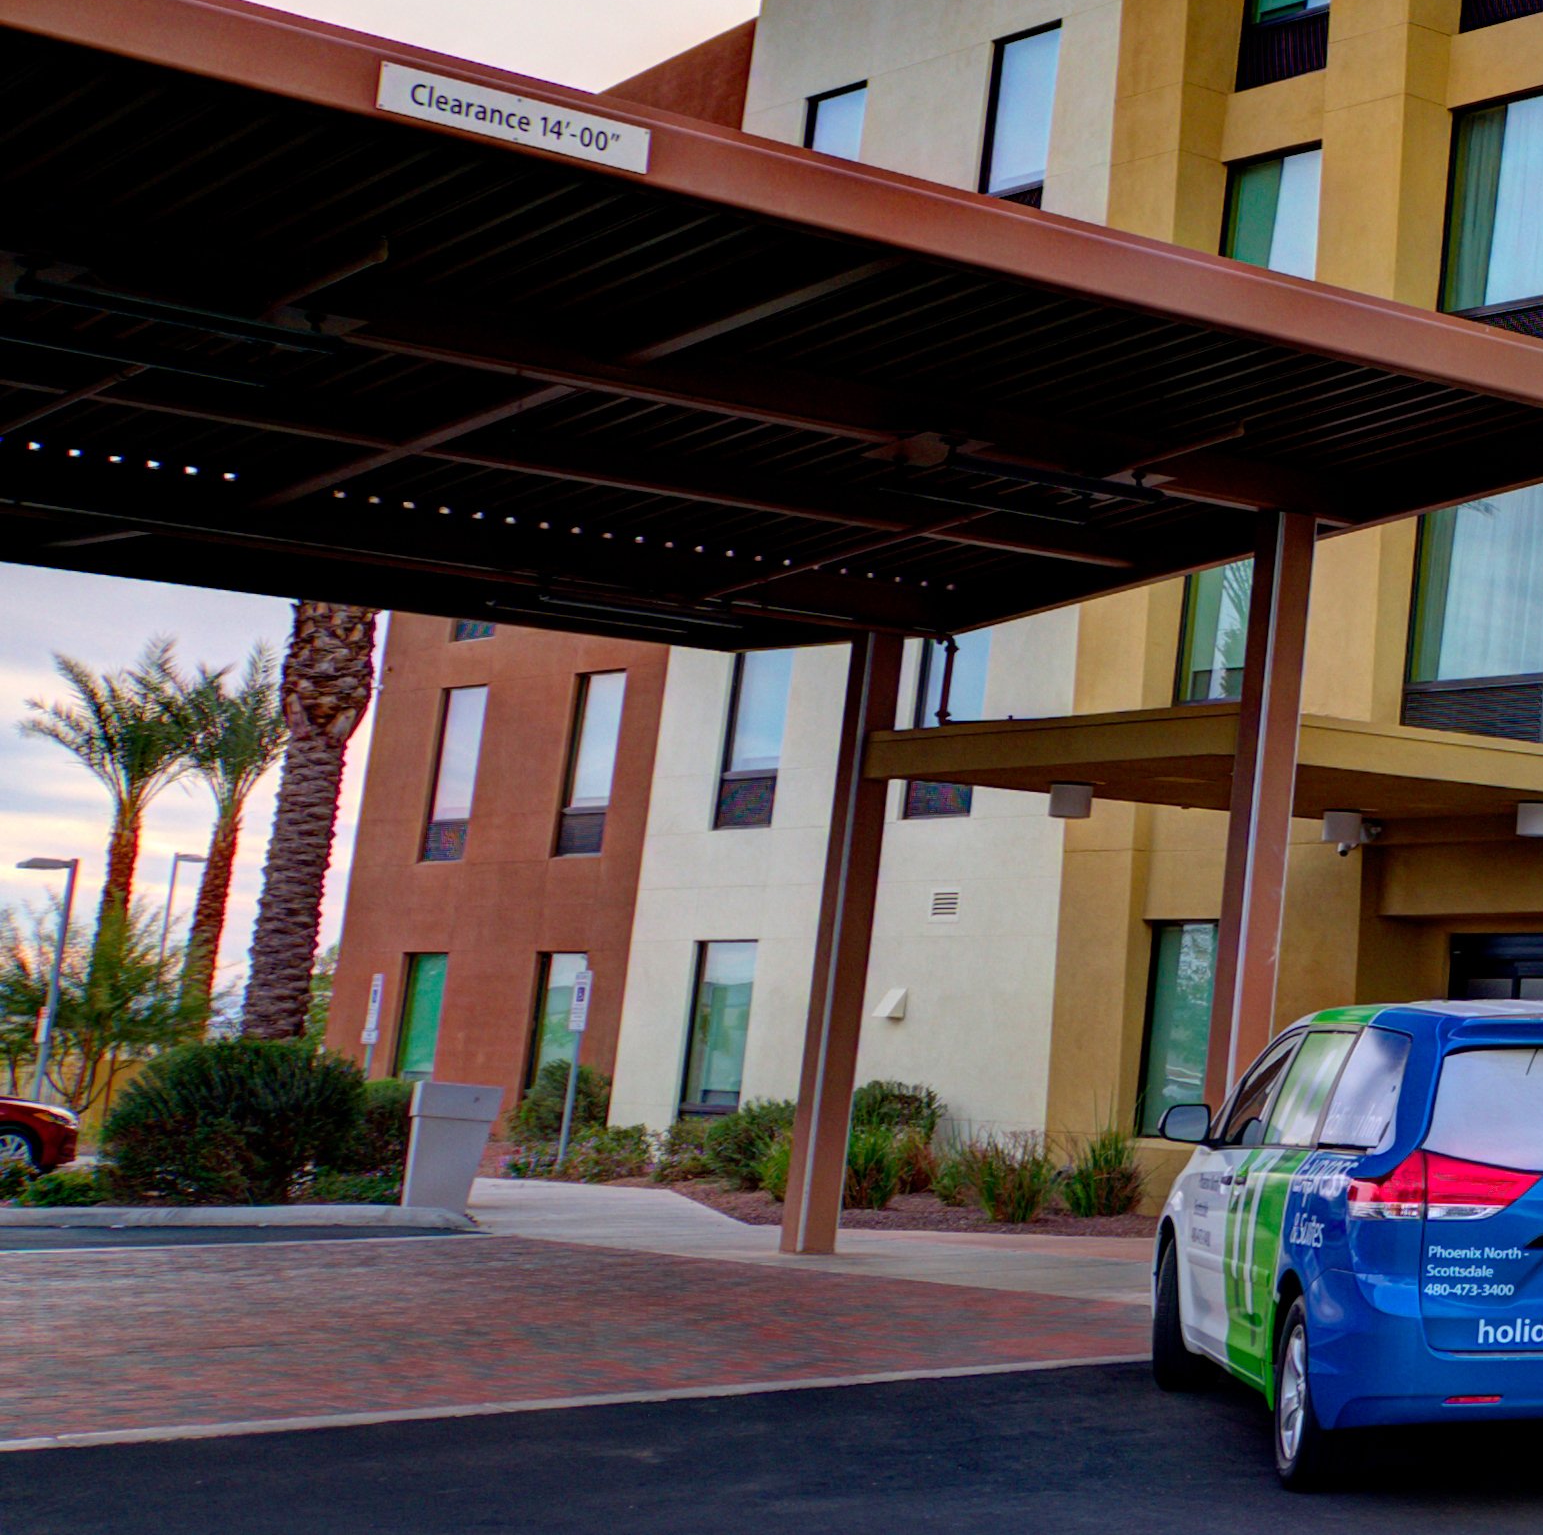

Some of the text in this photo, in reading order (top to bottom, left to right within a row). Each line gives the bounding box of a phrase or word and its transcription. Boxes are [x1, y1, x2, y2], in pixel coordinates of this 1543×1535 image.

[410, 83, 531, 133] Clearance
[1428, 1245, 1481, 1259] Phoenix
[1484, 1247, 1522, 1259] North
[1426, 1264, 1494, 1278] Scottsdale
[1424, 1283, 1515, 1296] 480-473-3400
